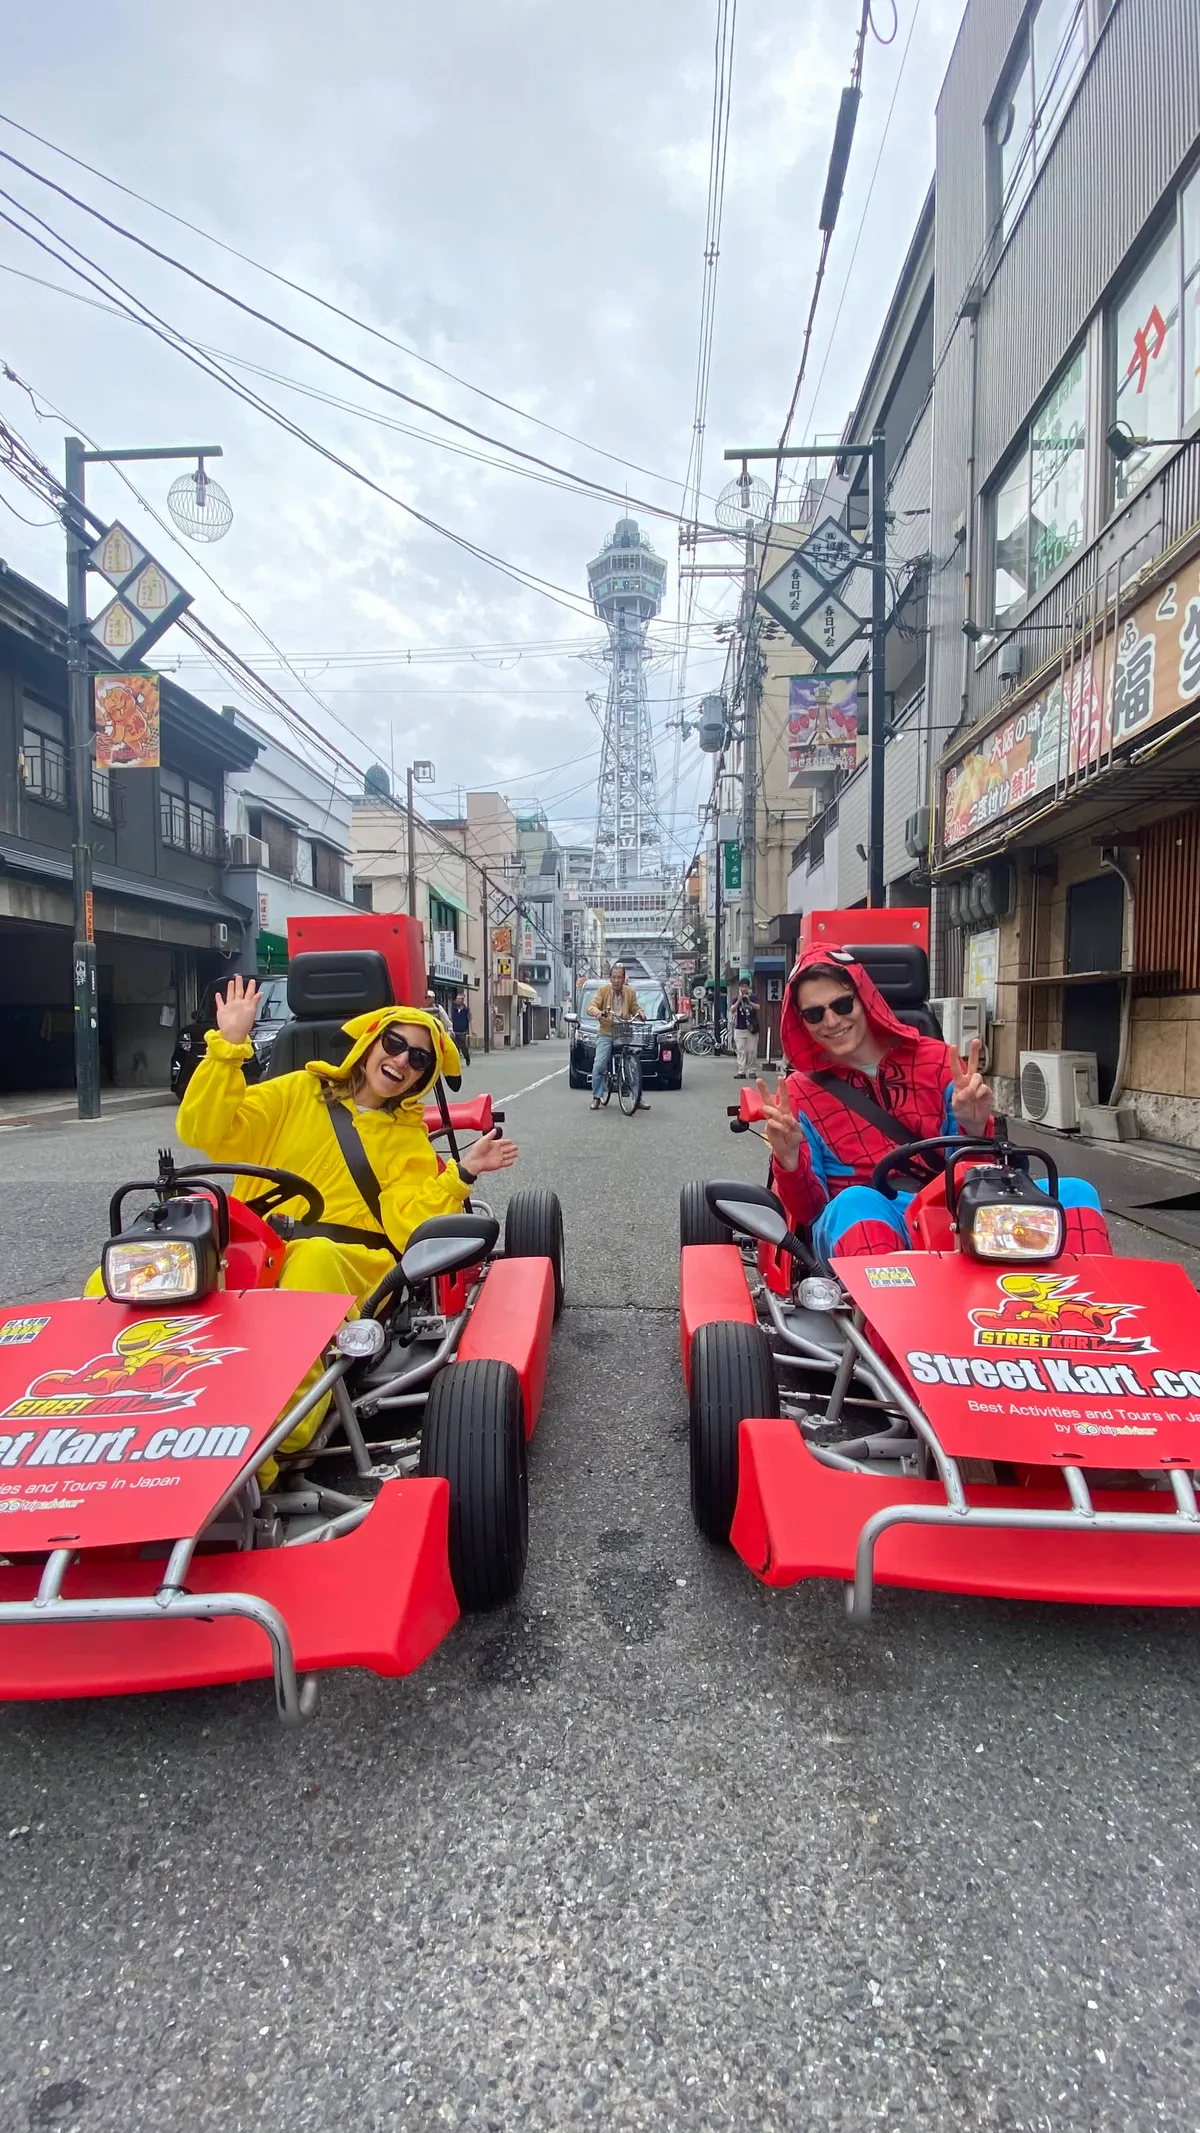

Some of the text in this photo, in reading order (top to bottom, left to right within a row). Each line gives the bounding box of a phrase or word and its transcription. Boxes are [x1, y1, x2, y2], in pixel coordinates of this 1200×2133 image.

[789, 568, 802, 611] 春日町会
[823, 605, 836, 648] 春日町会
[989, 703, 1042, 765] 大阪の味
[906, 1351, 1048, 1392] Street
[1042, 1358, 1148, 1398] Kart
[967, 1399, 1004, 1415] Best
[1009, 1404, 1082, 1420] Activities
[1085, 1407, 1114, 1421] and
[1115, 1409, 1163, 1422] Tours
[1165, 1410, 1182, 1423] in
[1055, 1422, 1071, 1435] by
[26, 1426, 137, 1466] Kart
[129, 1424, 251, 1460] .com
[25, 1480, 57, 1494] and
[62, 1479, 108, 1493] Tours
[110, 1477, 125, 1490] in
[130, 1475, 181, 1489] Japan
